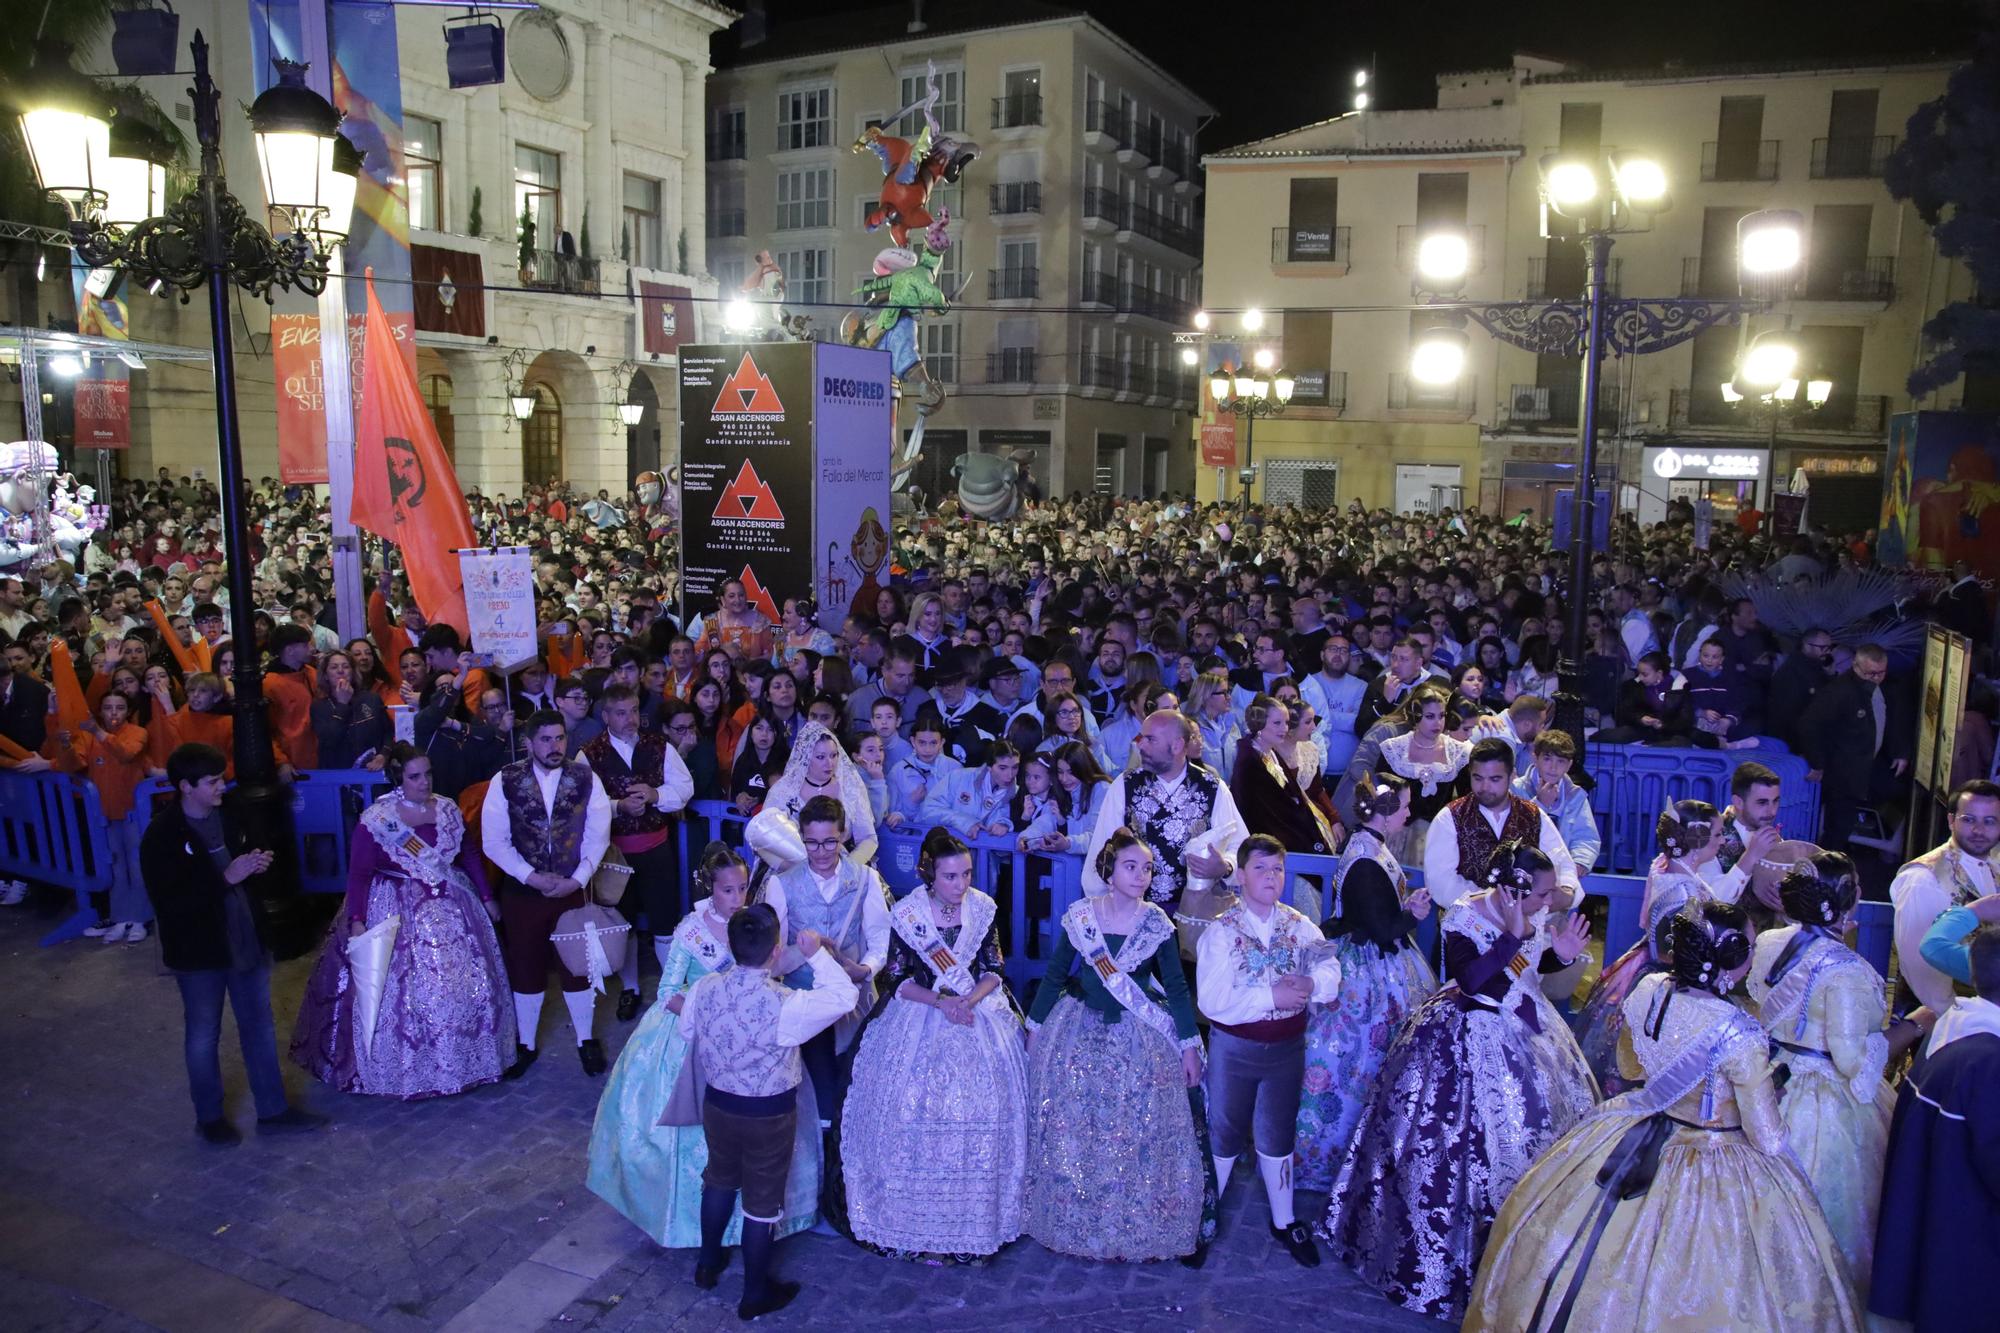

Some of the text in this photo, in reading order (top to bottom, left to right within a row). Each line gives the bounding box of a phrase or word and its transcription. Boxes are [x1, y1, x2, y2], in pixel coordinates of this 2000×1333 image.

[1307, 232, 1329, 241] Venta
[1301, 376, 1323, 384] Venta
[824, 377, 884, 400] DECOFRED
[736, 414, 785, 422] ASCENSORES
[844, 469, 856, 482] del
[858, 469, 884, 481] Mercat
[711, 519, 785, 529] ASGAN ASCENSORES
[719, 535, 775, 543] www.asgan.eu
[757, 545, 790, 553] valencia
[495, 614, 504, 628] 4
